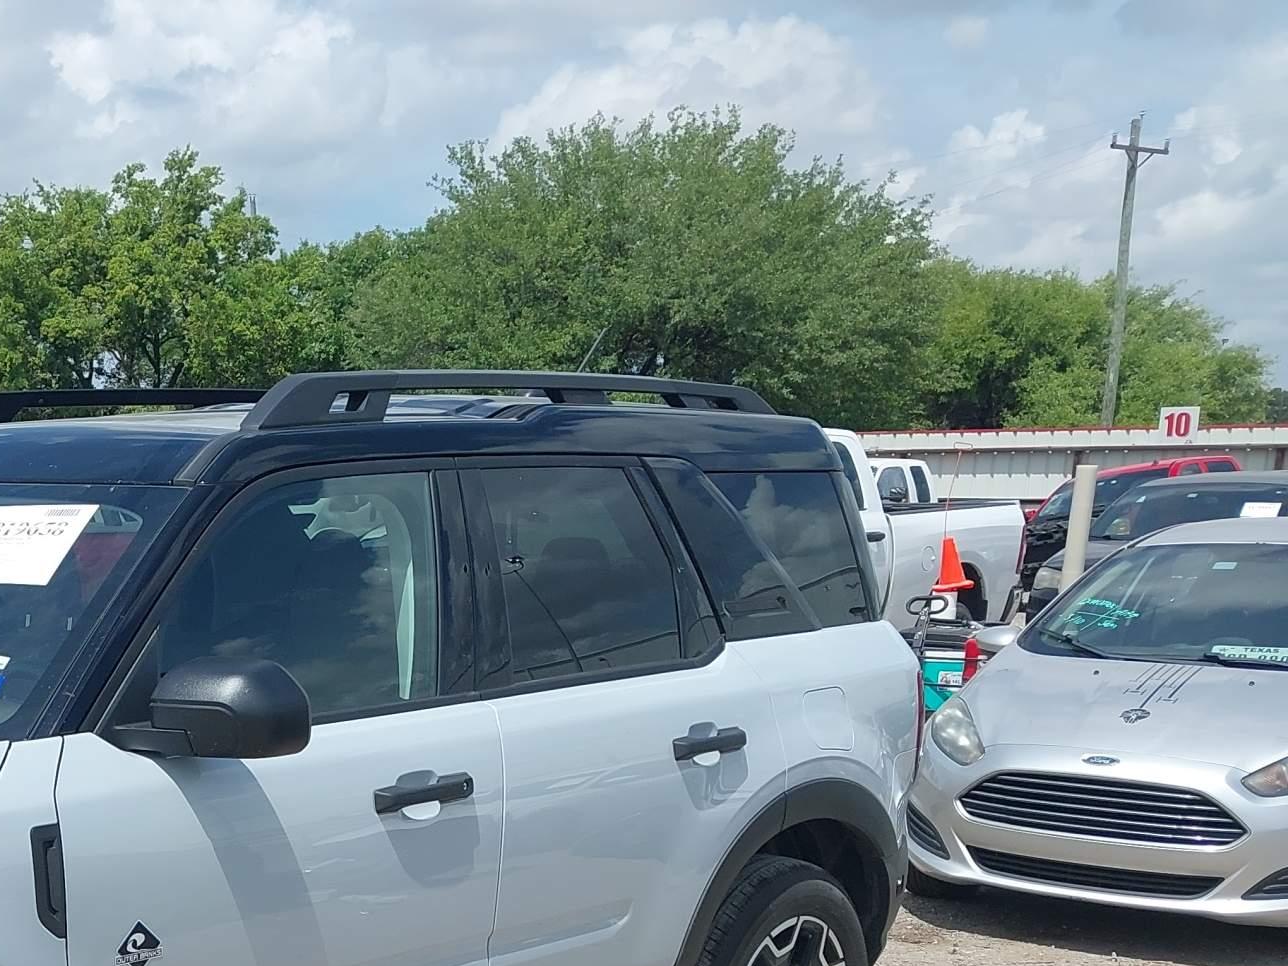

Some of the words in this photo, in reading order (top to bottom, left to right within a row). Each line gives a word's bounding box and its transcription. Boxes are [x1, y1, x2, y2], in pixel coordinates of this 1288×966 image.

[1164, 412, 1191, 437] 10
[115, 954, 138, 964] OUTER
[139, 949, 162, 960] BANKS
